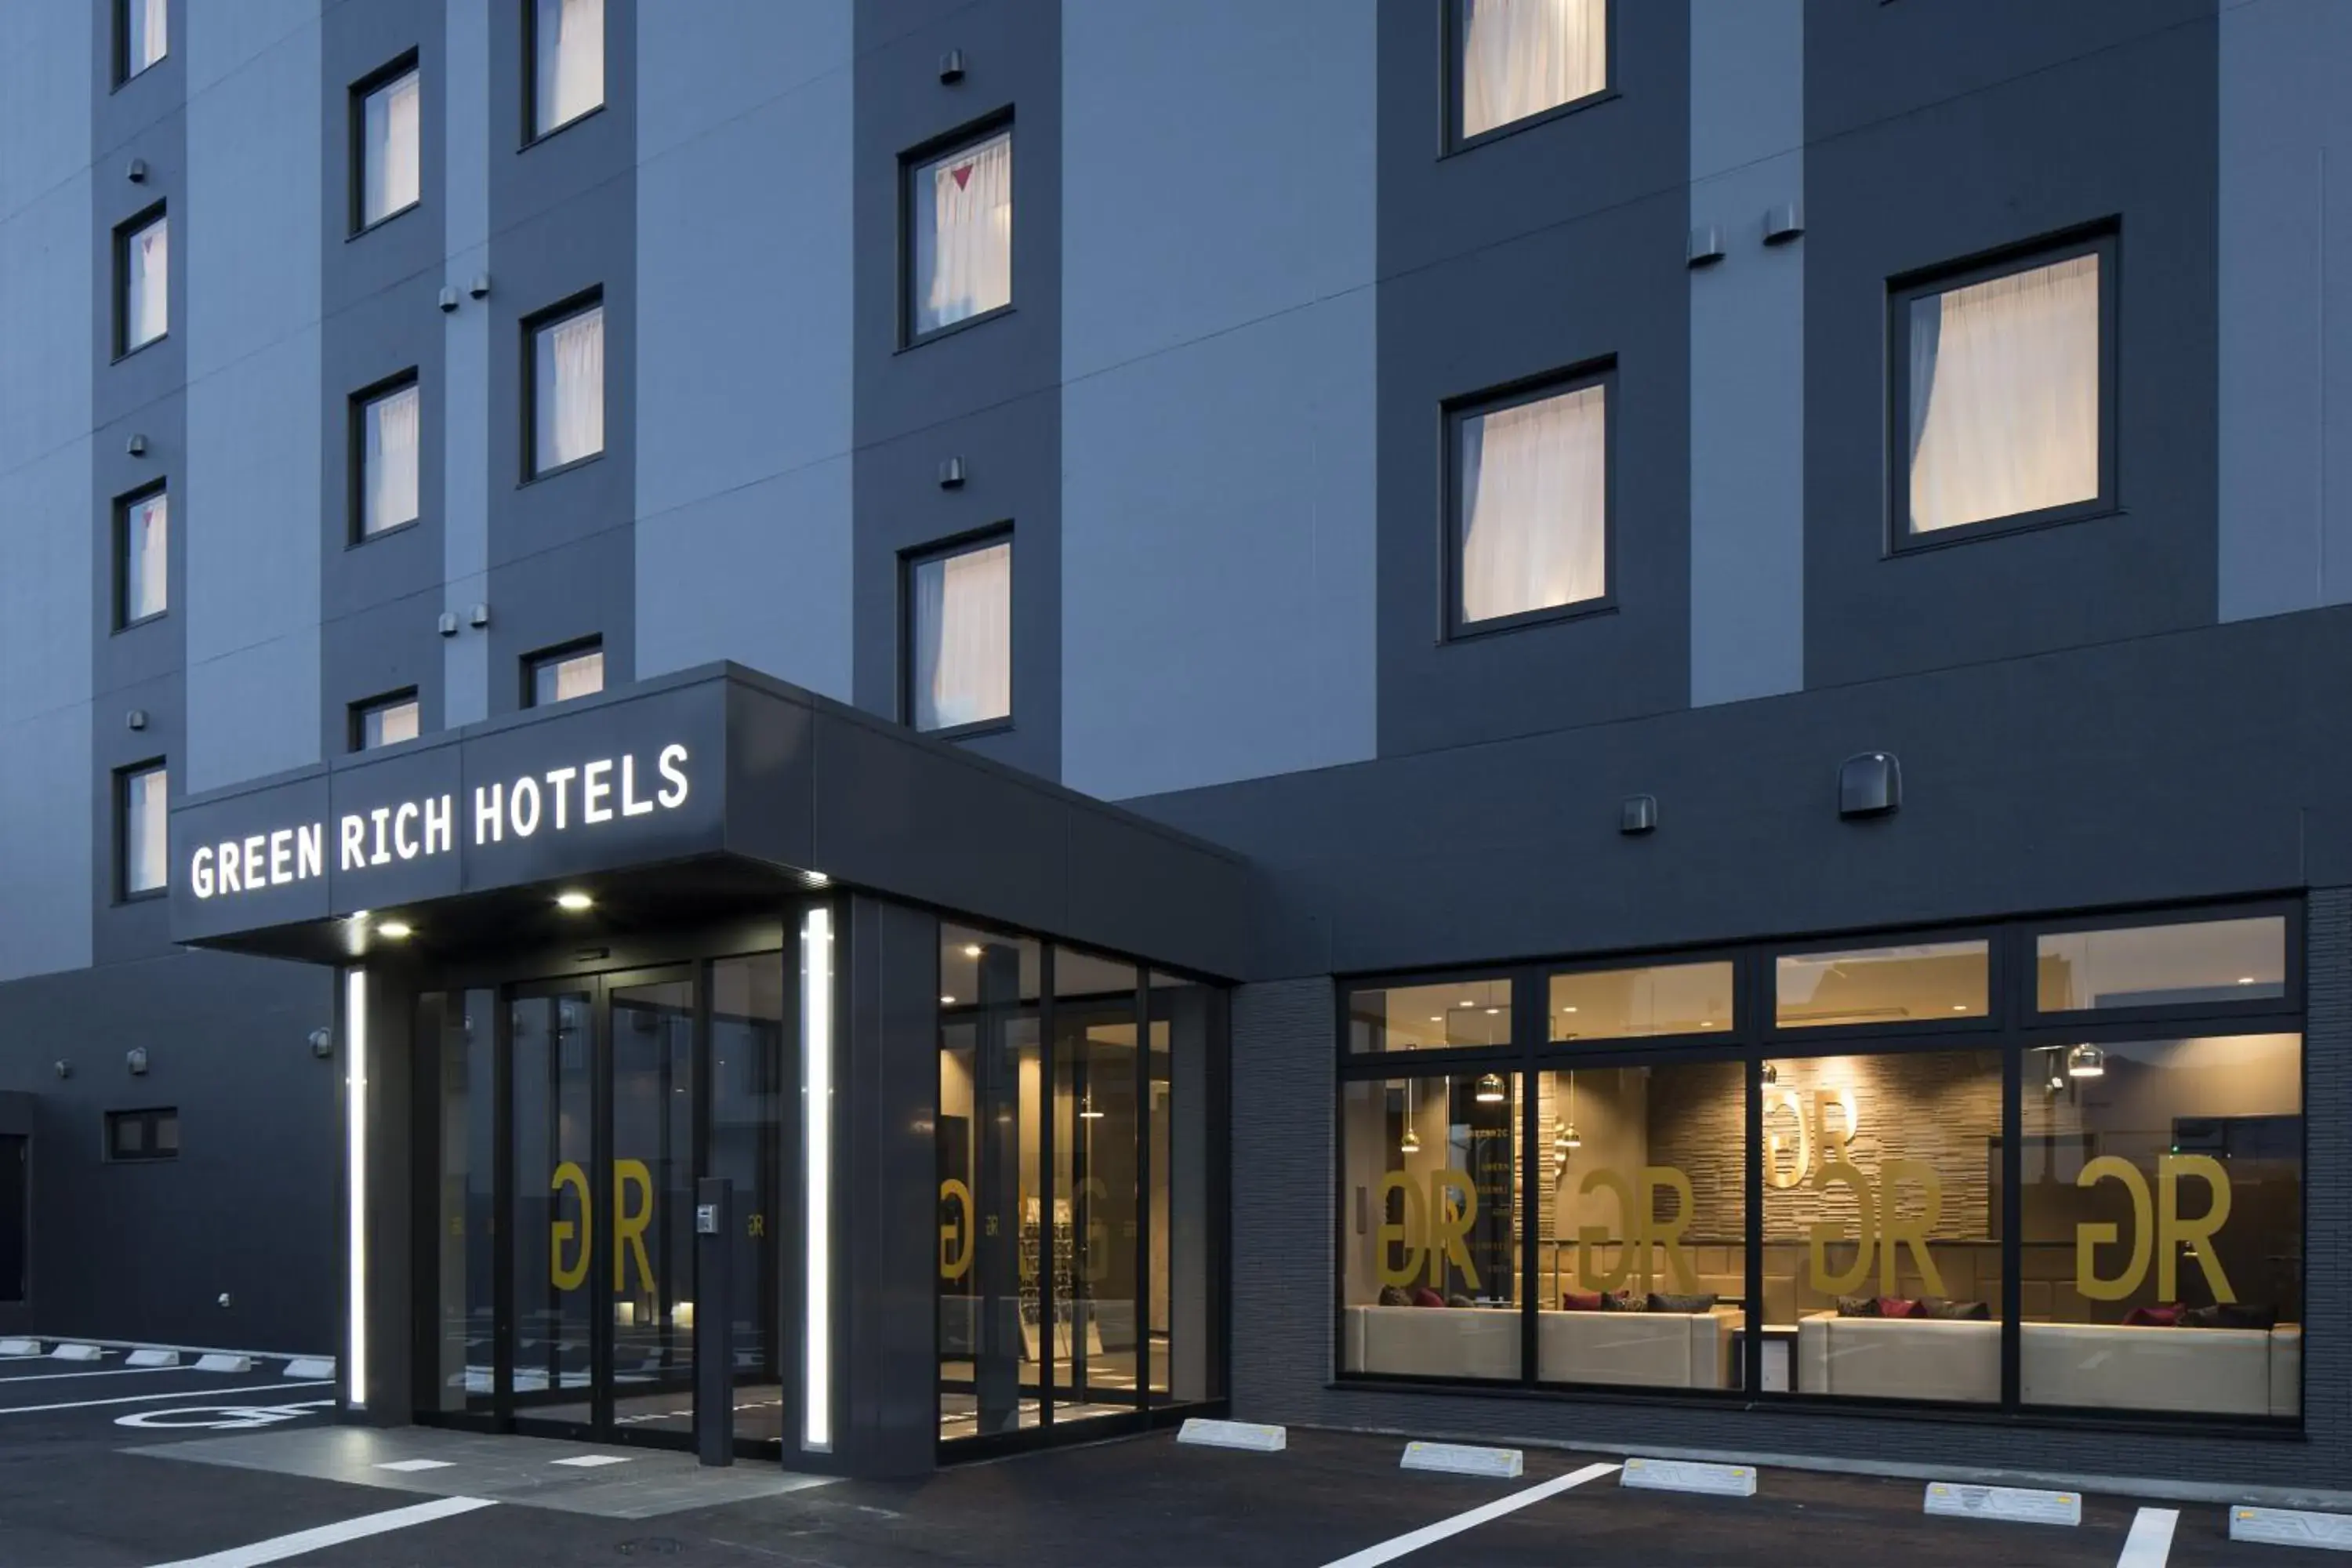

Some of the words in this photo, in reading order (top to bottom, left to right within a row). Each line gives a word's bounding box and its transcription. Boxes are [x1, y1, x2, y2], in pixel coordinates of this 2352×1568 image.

[191, 822, 322, 898] GREEN
[340, 794, 452, 870] RICH
[475, 743, 688, 845] HOTELS
